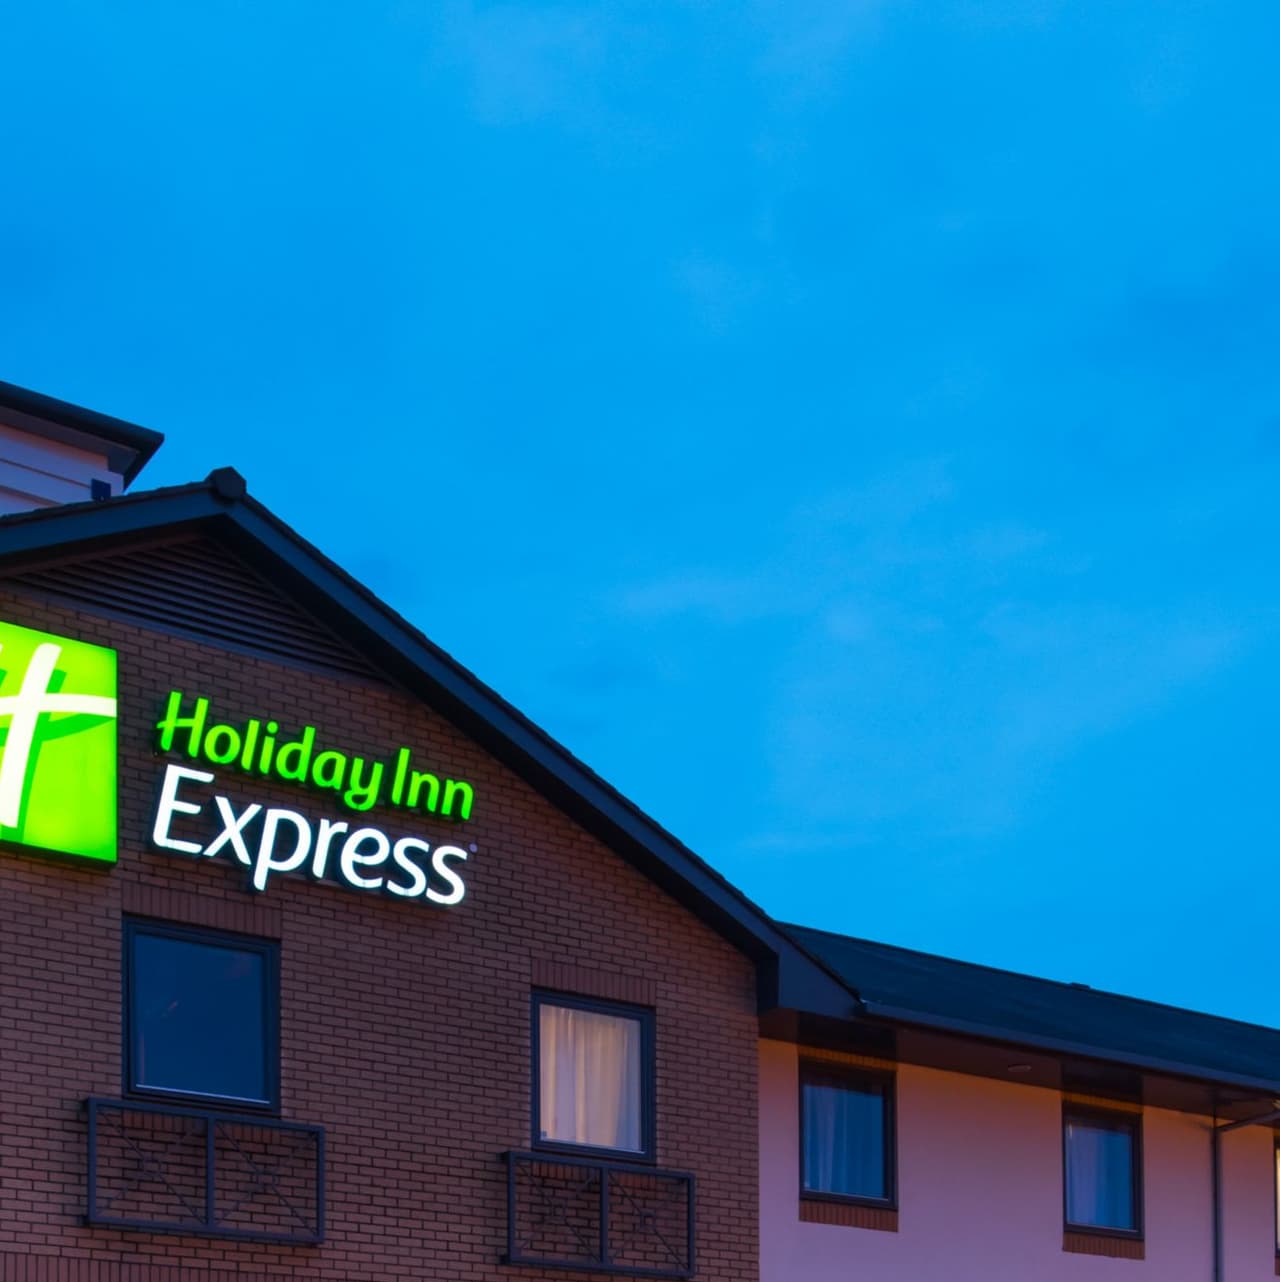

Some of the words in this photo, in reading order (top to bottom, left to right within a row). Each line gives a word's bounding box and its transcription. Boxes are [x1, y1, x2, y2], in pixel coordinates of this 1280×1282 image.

[156, 690, 383, 812] Holiday
[391, 747, 474, 821] Inn
[152, 763, 468, 906] Express
